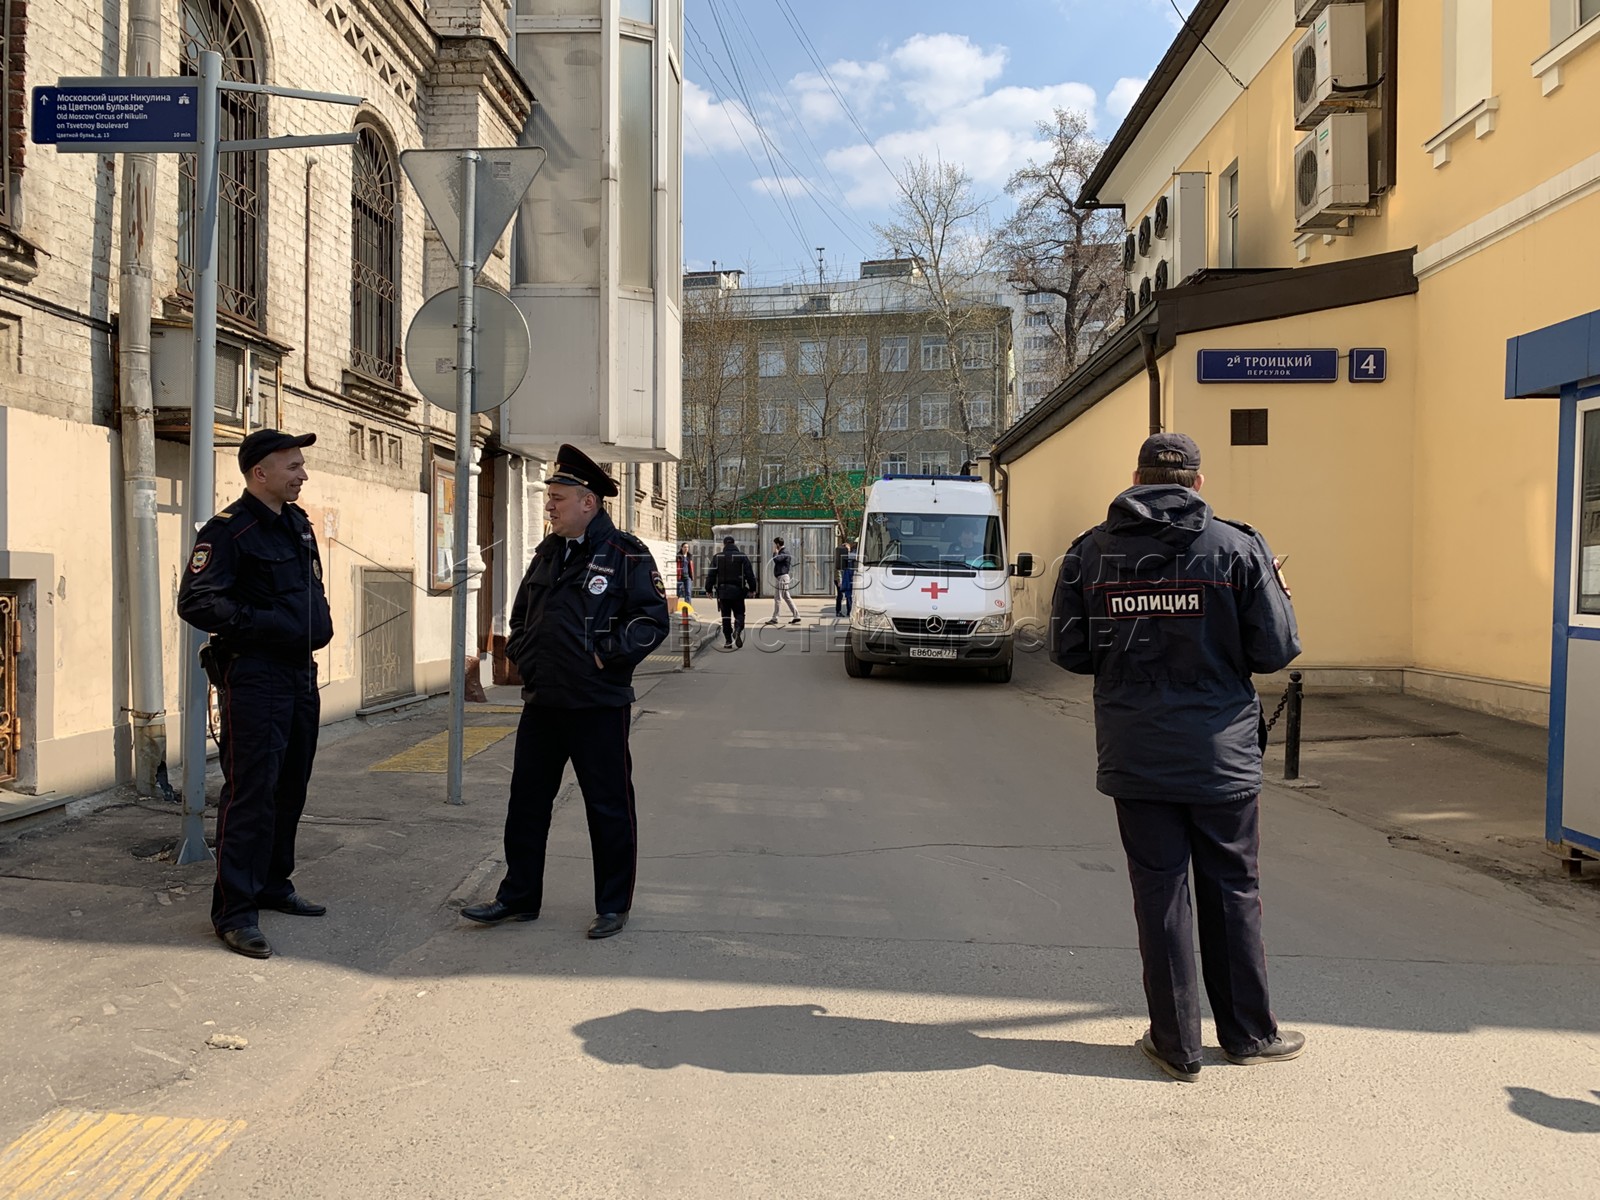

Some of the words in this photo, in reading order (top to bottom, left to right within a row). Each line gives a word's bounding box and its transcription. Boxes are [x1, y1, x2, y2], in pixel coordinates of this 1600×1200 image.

[108, 95, 129, 103] цирк
[130, 94, 171, 103] Никулина
[69, 103, 104, 112] Цветном
[106, 103, 144, 112] Бульваре
[66, 122, 95, 130] Tsvetnoy
[1245, 354, 1312, 368] ТРОИЦКИЙ
[1360, 354, 1377, 375] 4
[1111, 594, 1200, 614] ПОЛИЦИЯ
